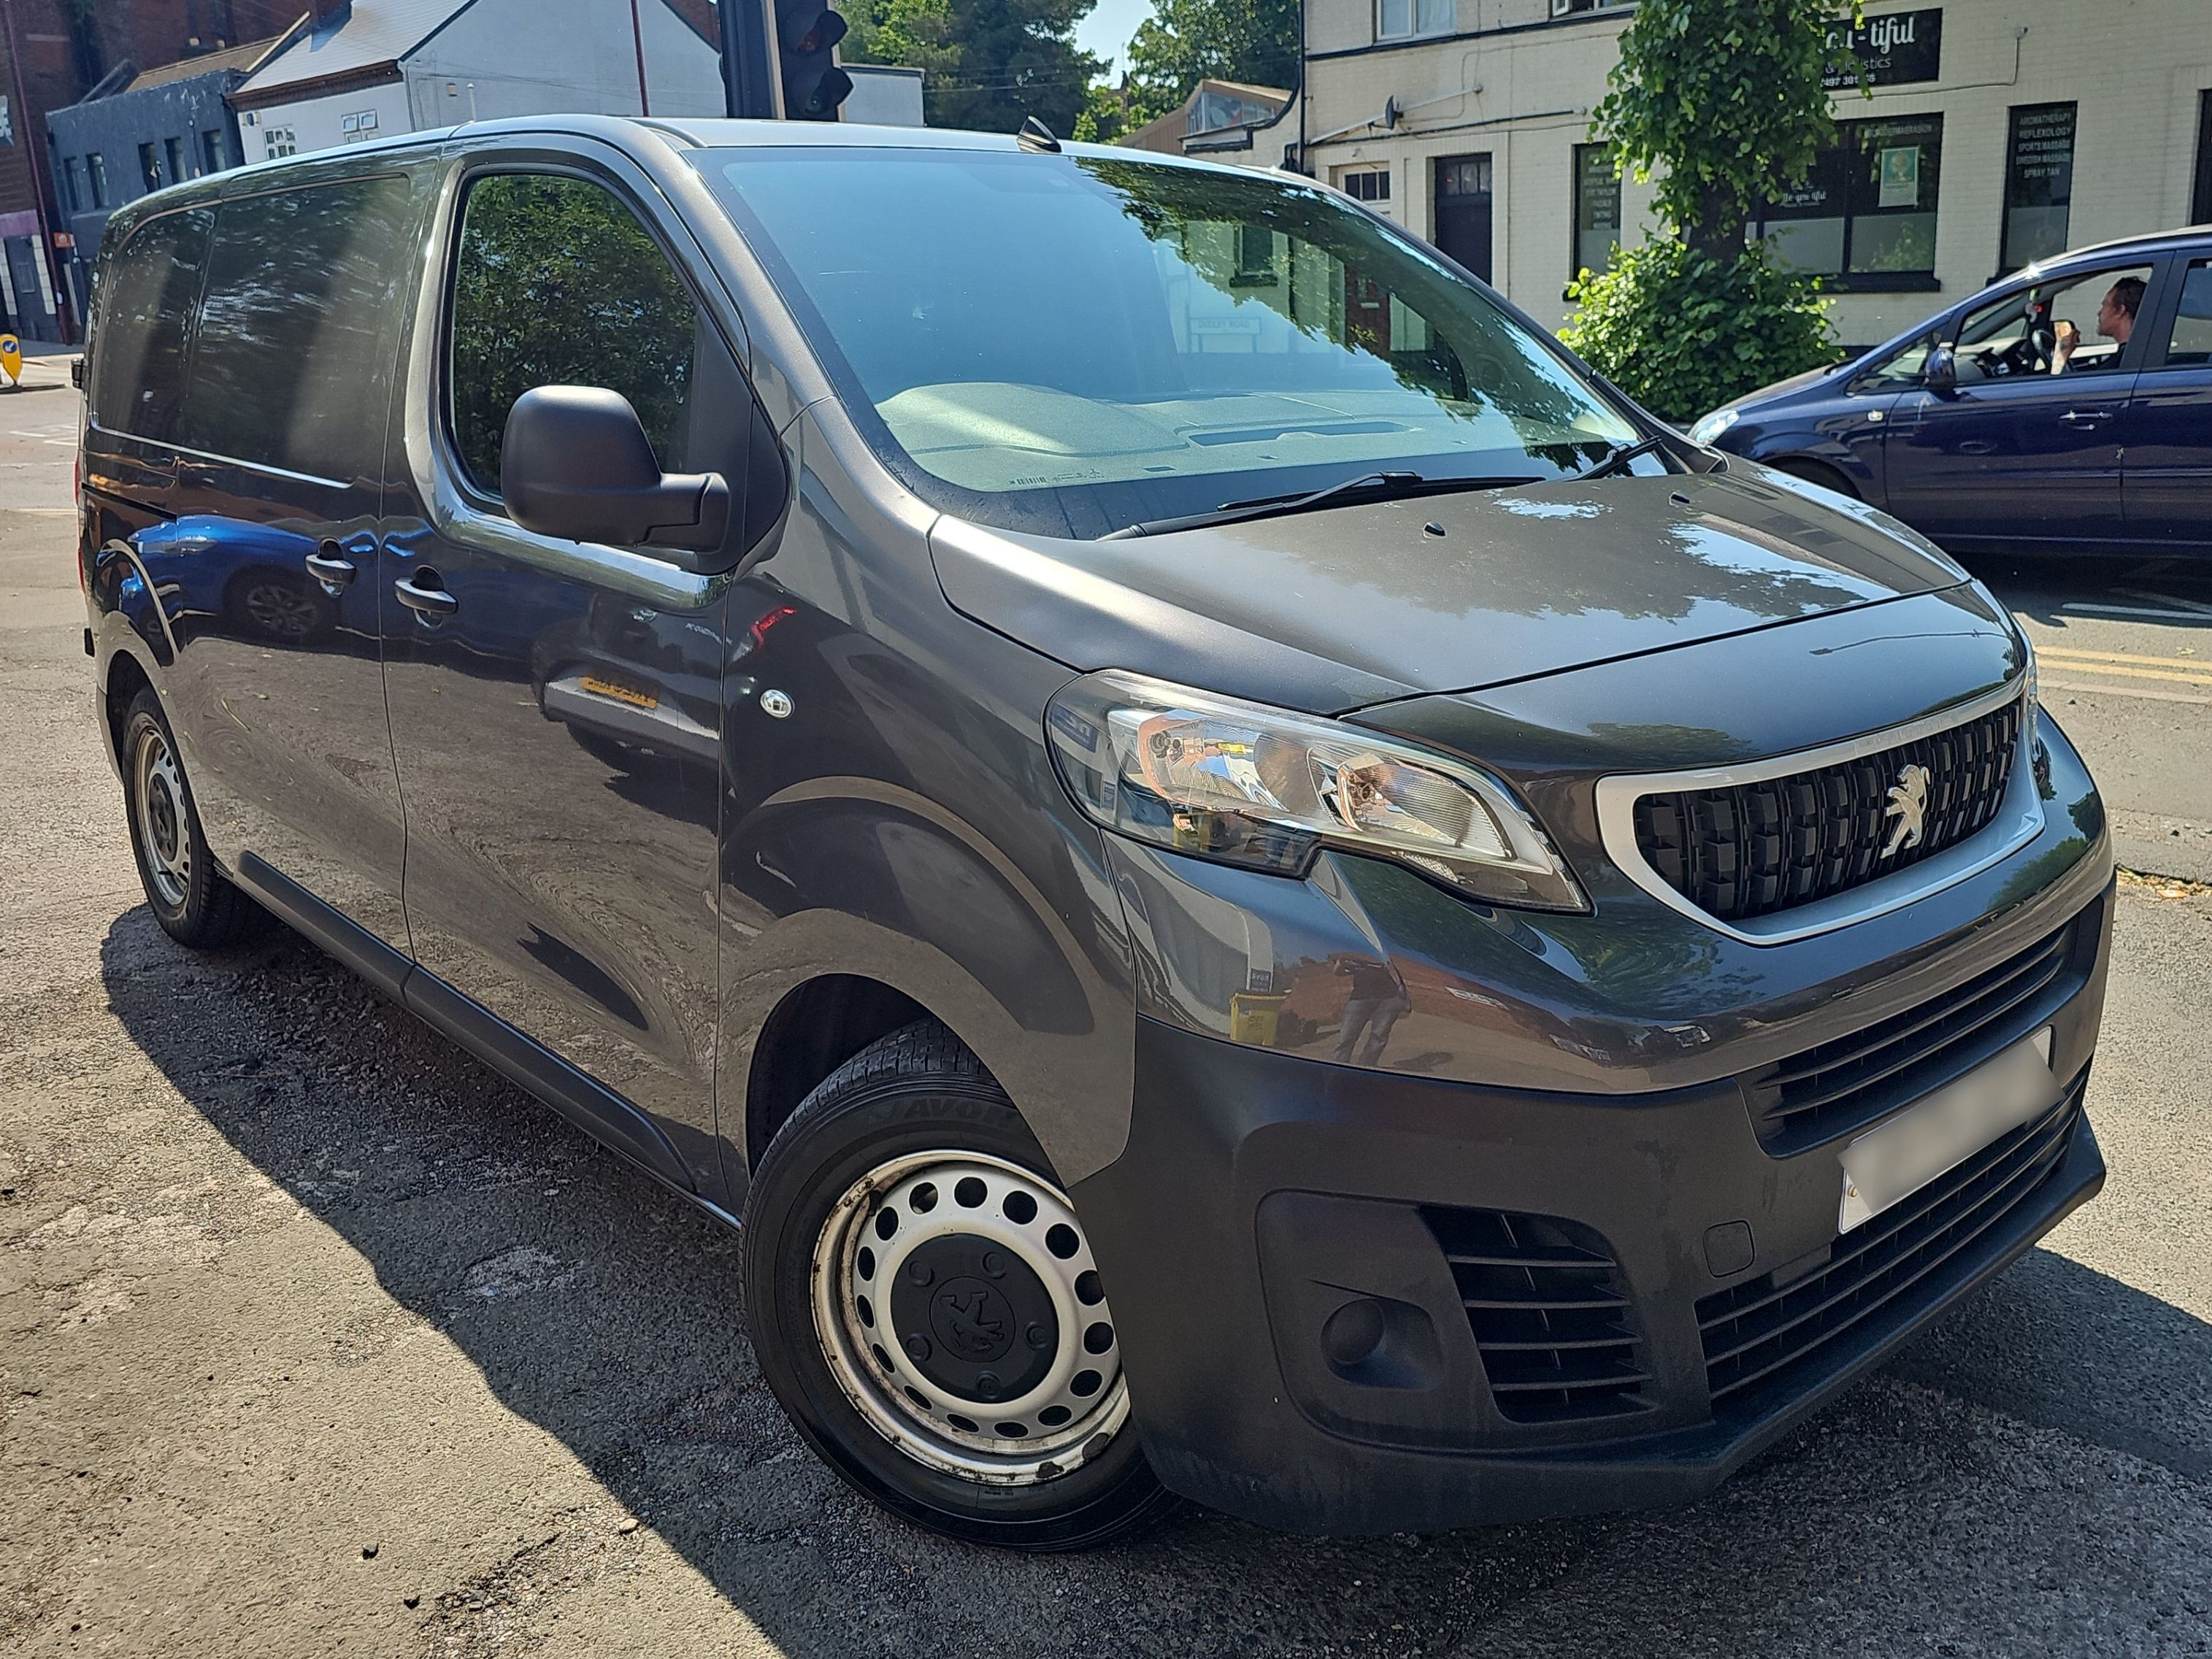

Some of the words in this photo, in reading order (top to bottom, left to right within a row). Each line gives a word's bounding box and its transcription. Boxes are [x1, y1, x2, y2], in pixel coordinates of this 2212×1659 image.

[2019, 127, 2071, 139] REFLEXOLOGY
[2018, 141, 2041, 153] SPORTS
[2042, 139, 2071, 150] MASSAGE
